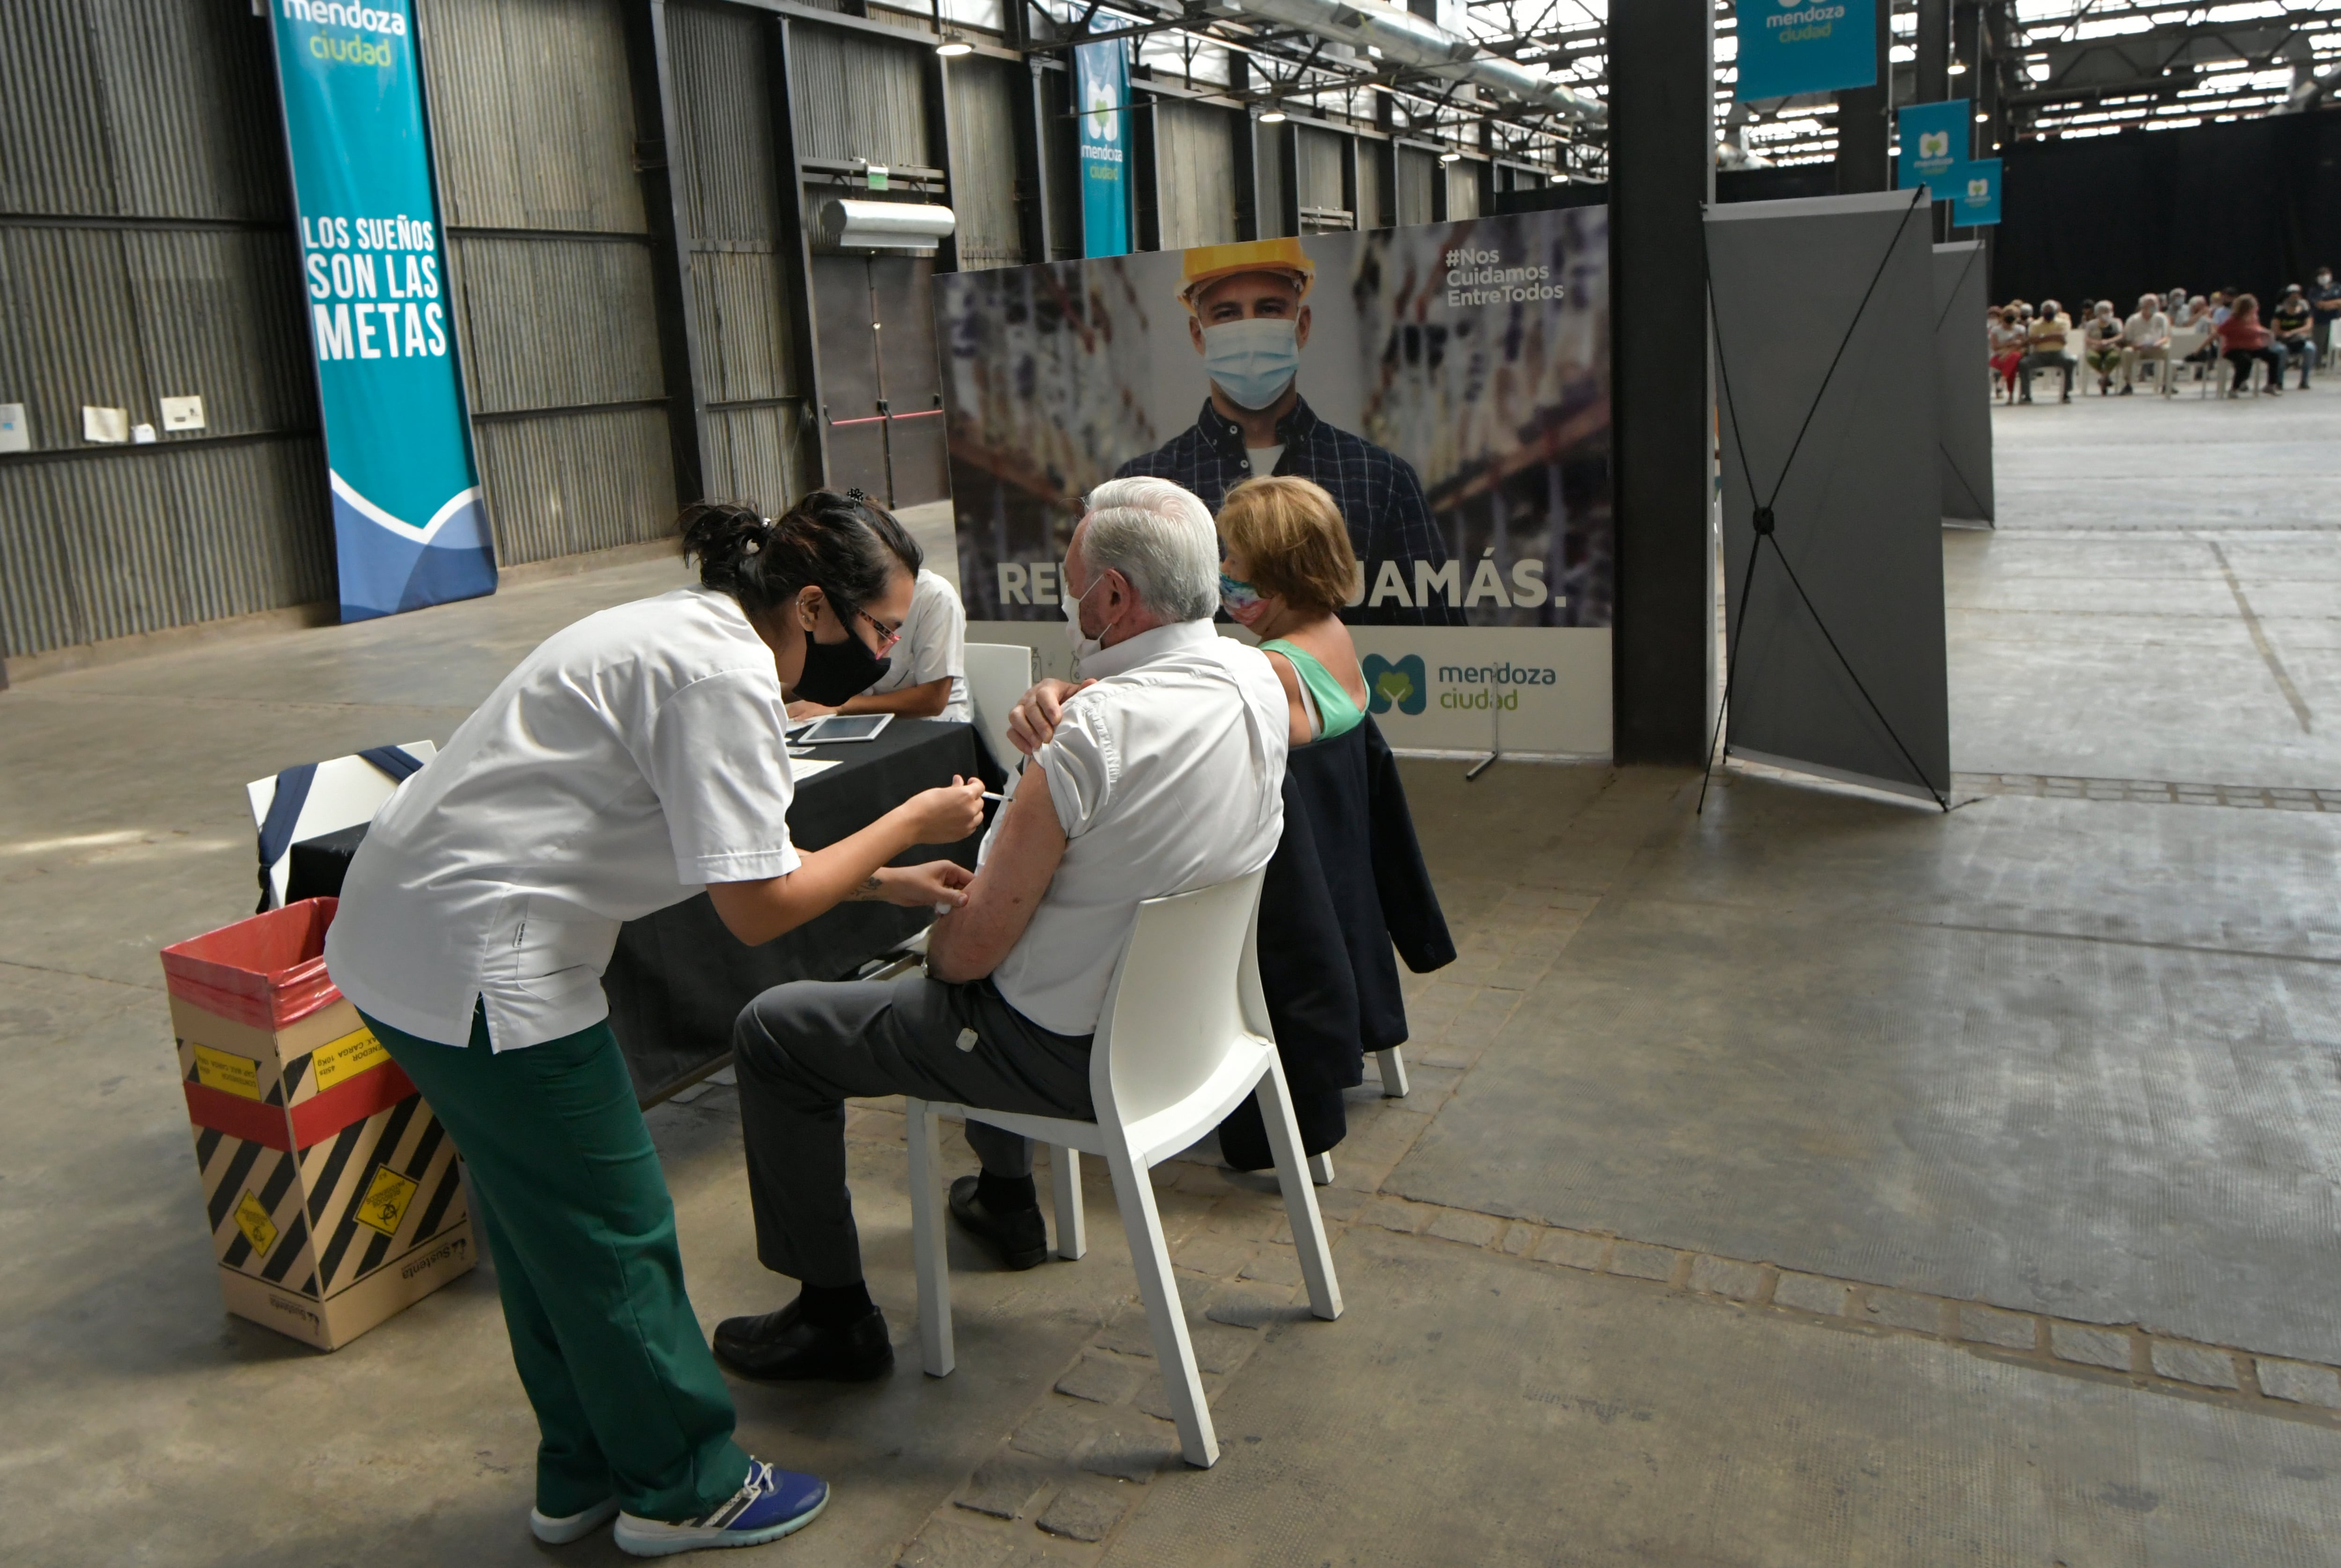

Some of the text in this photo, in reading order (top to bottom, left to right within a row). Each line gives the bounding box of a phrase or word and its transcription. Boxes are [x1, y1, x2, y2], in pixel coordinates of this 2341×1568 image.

[283, 0, 406, 36] mendoza
[1766, 6, 1845, 28] mendoza
[1779, 22, 1832, 43] ciudad
[309, 29, 391, 67] ciudad
[1081, 144, 1122, 162] mendoza
[302, 214, 434, 251] LOS SUEÑOS
[1445, 248, 1500, 267] #Nos
[307, 252, 439, 299] SON LAS
[1446, 265, 1550, 287] Cuidamos
[313, 302, 447, 361] METAS
[1344, 547, 1567, 608] JAMÁS.
[1439, 662, 1556, 685] mendoza
[317, 1055, 335, 1067] 10Kg
[337, 1042, 364, 1058] CARGA
[352, 1043, 383, 1062] ENEDOR
[402, 1246, 450, 1279] Sustenta
